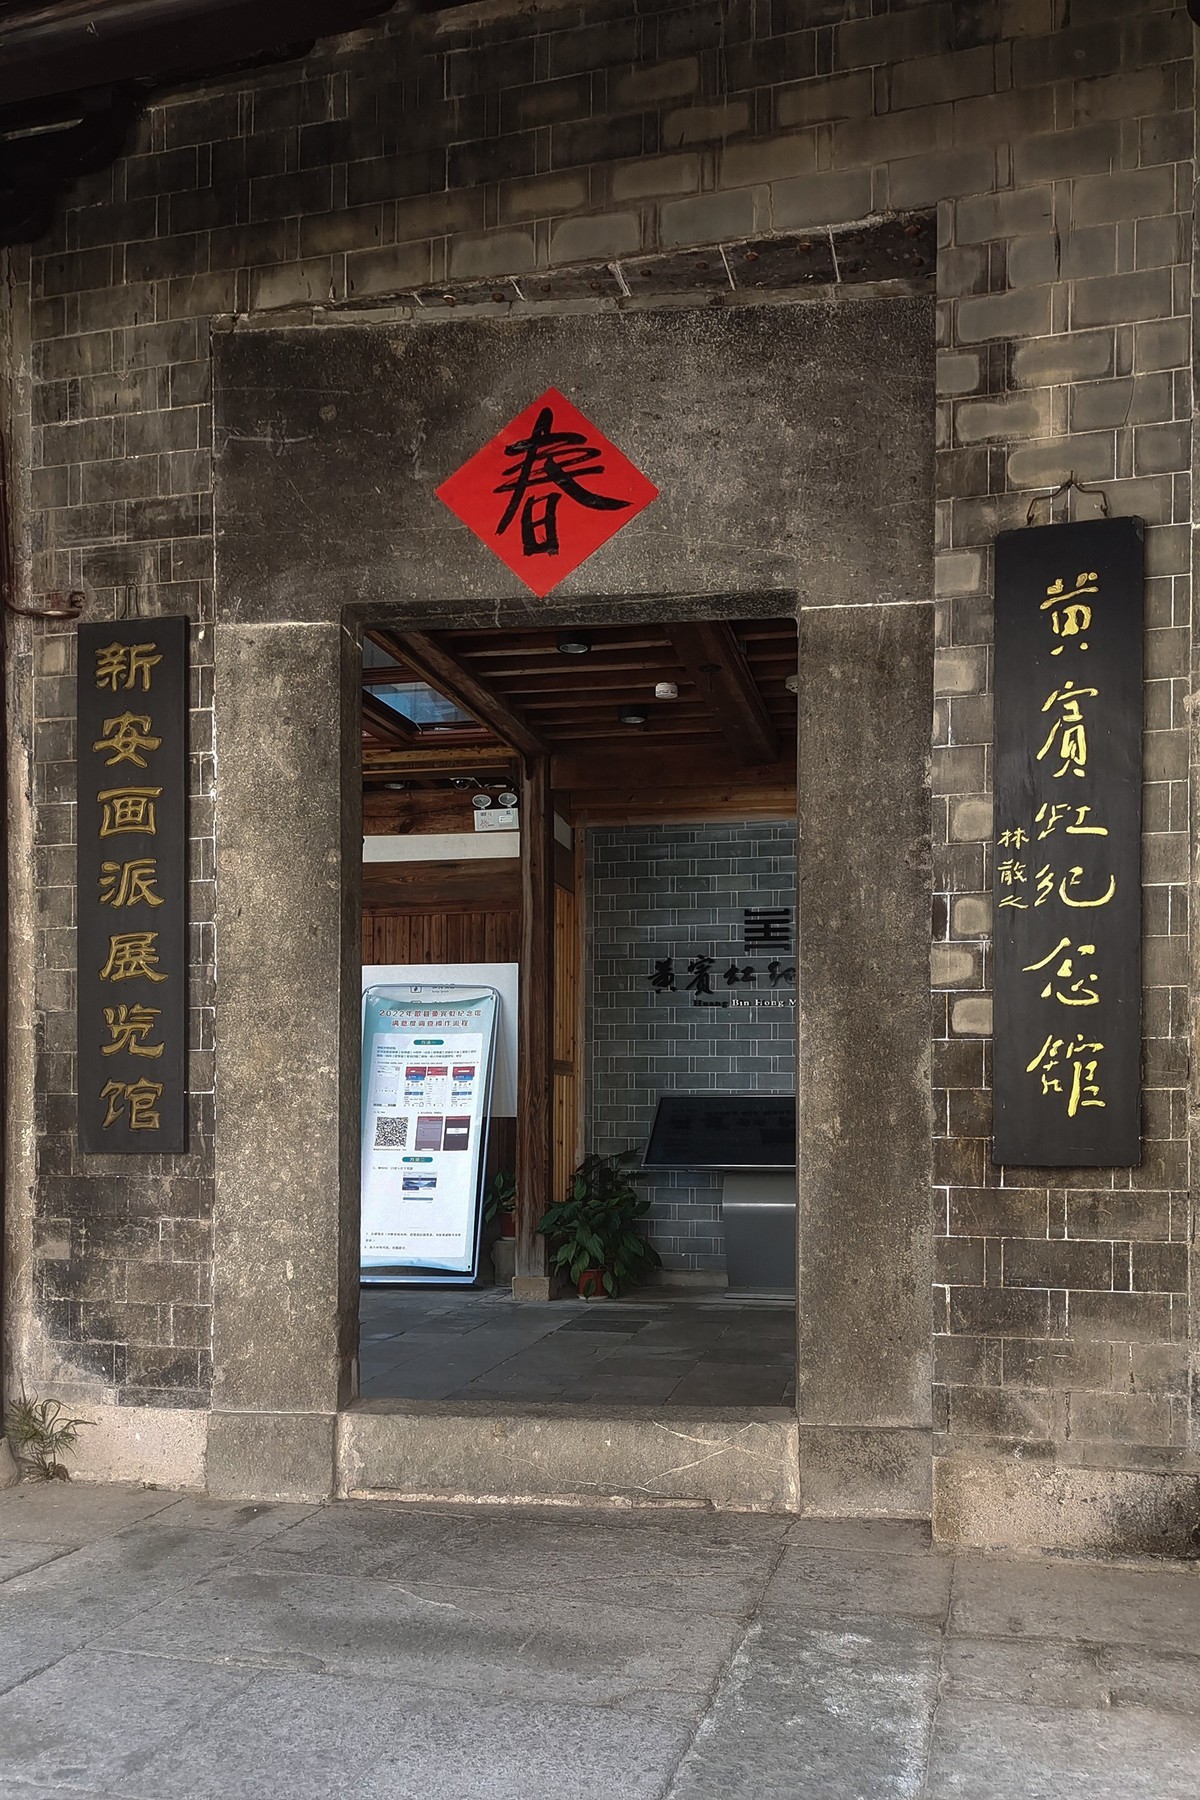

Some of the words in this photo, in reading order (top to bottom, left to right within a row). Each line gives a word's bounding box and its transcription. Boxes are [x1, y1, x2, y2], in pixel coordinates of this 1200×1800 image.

[495, 406, 634, 556] 春
[92, 641, 168, 1131] 新安画派展览馆
[693, 1000, 729, 1008] Huang
[755, 999, 785, 1008] Hong
